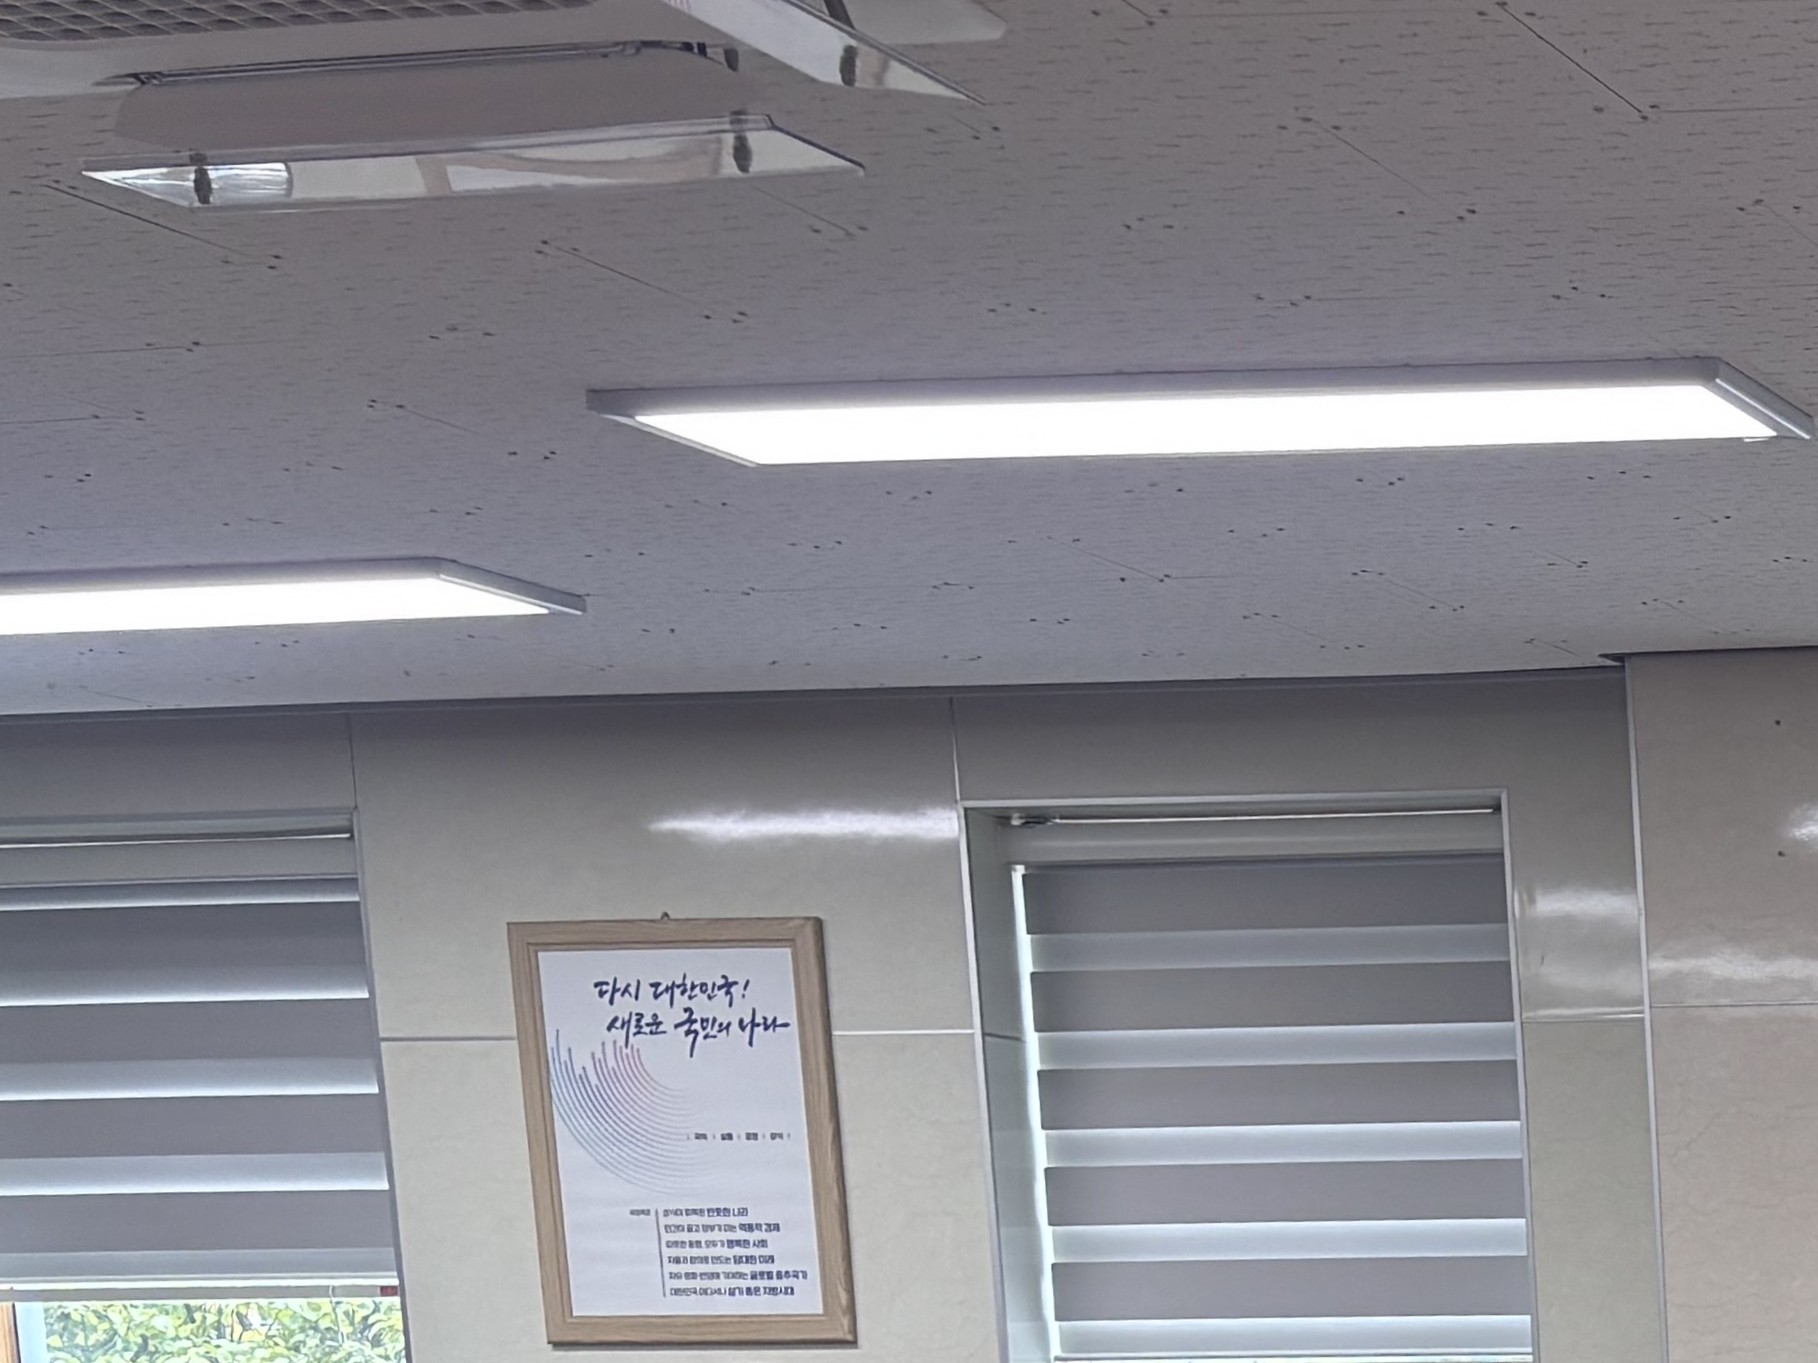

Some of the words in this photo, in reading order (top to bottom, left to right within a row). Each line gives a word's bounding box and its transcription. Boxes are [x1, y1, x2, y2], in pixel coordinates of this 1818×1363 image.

[593, 976, 641, 1006] 다시
[649, 972, 750, 1008] 대한민국!
[606, 1011, 667, 1049] 새로운
[673, 1007, 732, 1058] 국민의
[738, 1007, 791, 1047] 나라
